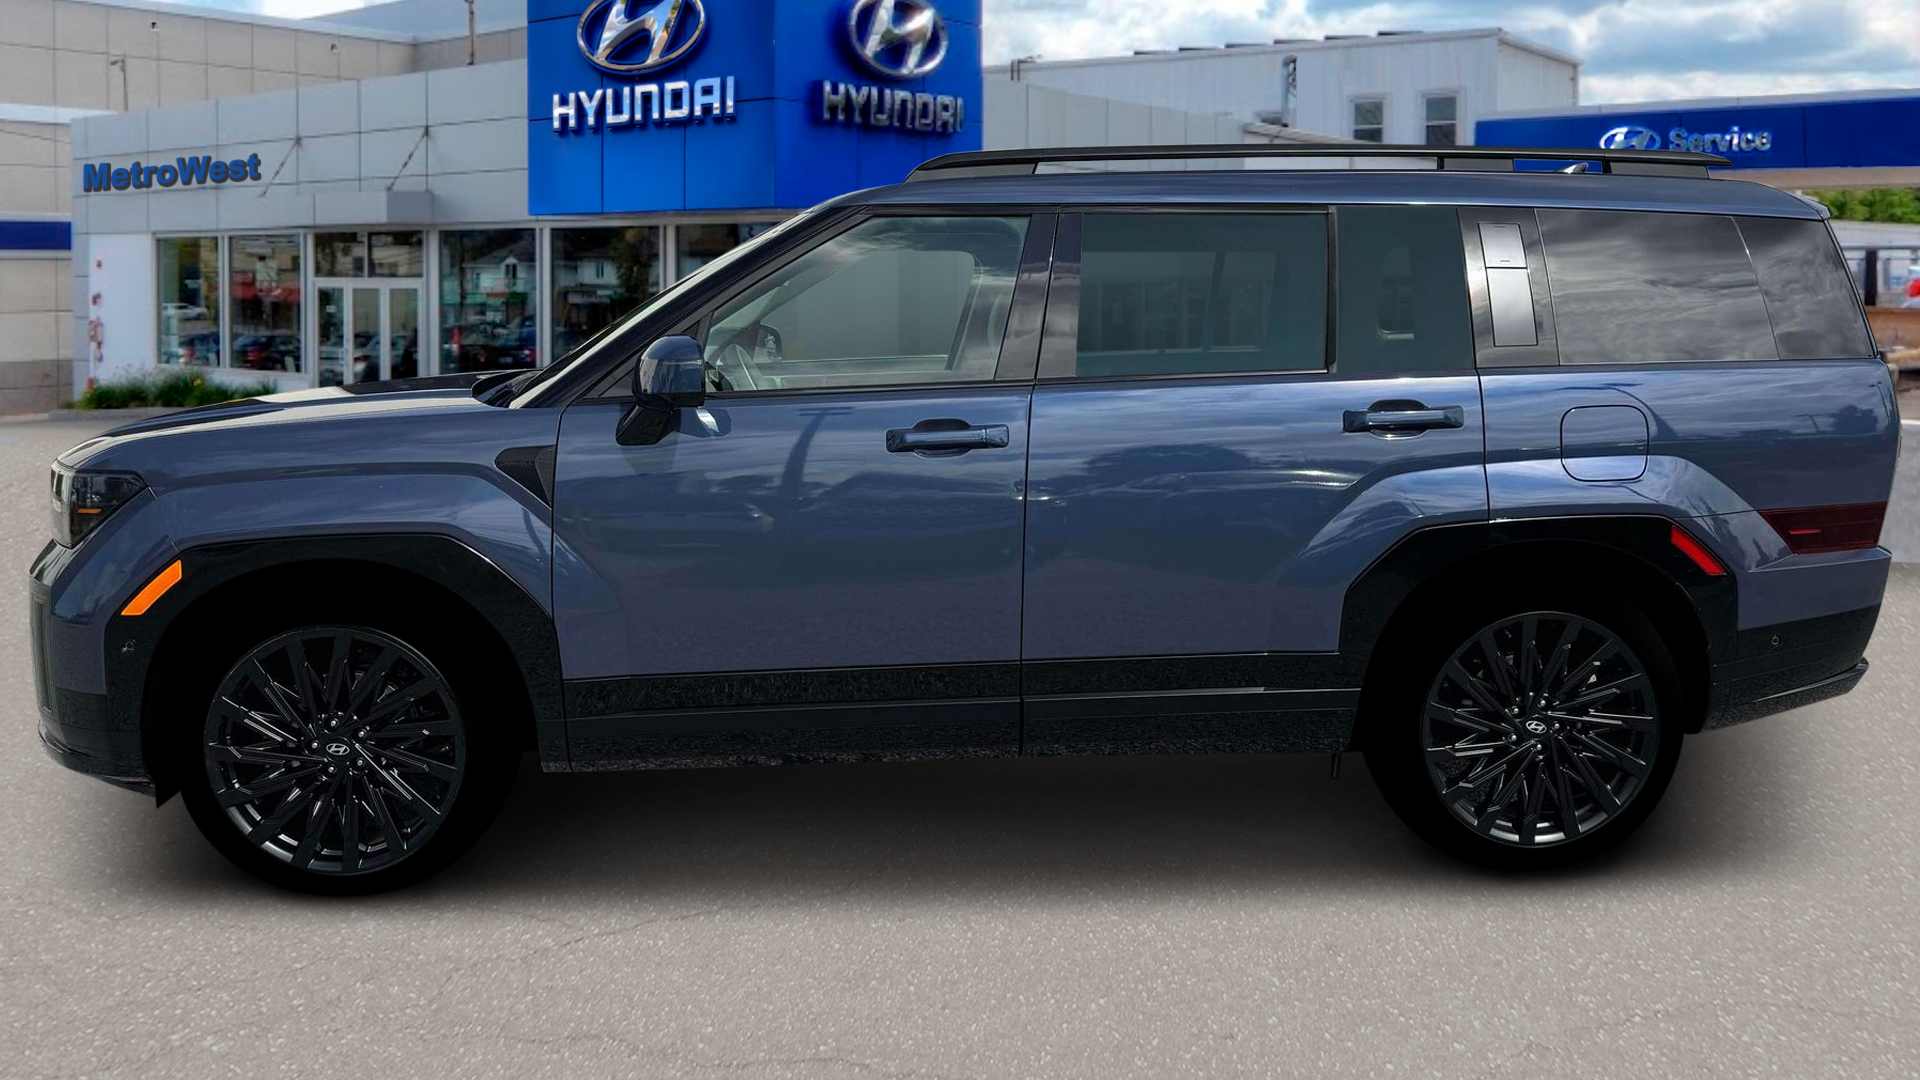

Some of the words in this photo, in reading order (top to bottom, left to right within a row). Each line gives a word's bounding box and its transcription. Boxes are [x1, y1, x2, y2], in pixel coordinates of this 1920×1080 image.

[552, 75, 736, 132] HYUNDAI
[822, 80, 963, 133] HYUNDAI
[1668, 125, 1771, 152] Service
[82, 153, 261, 192] MetroWest
